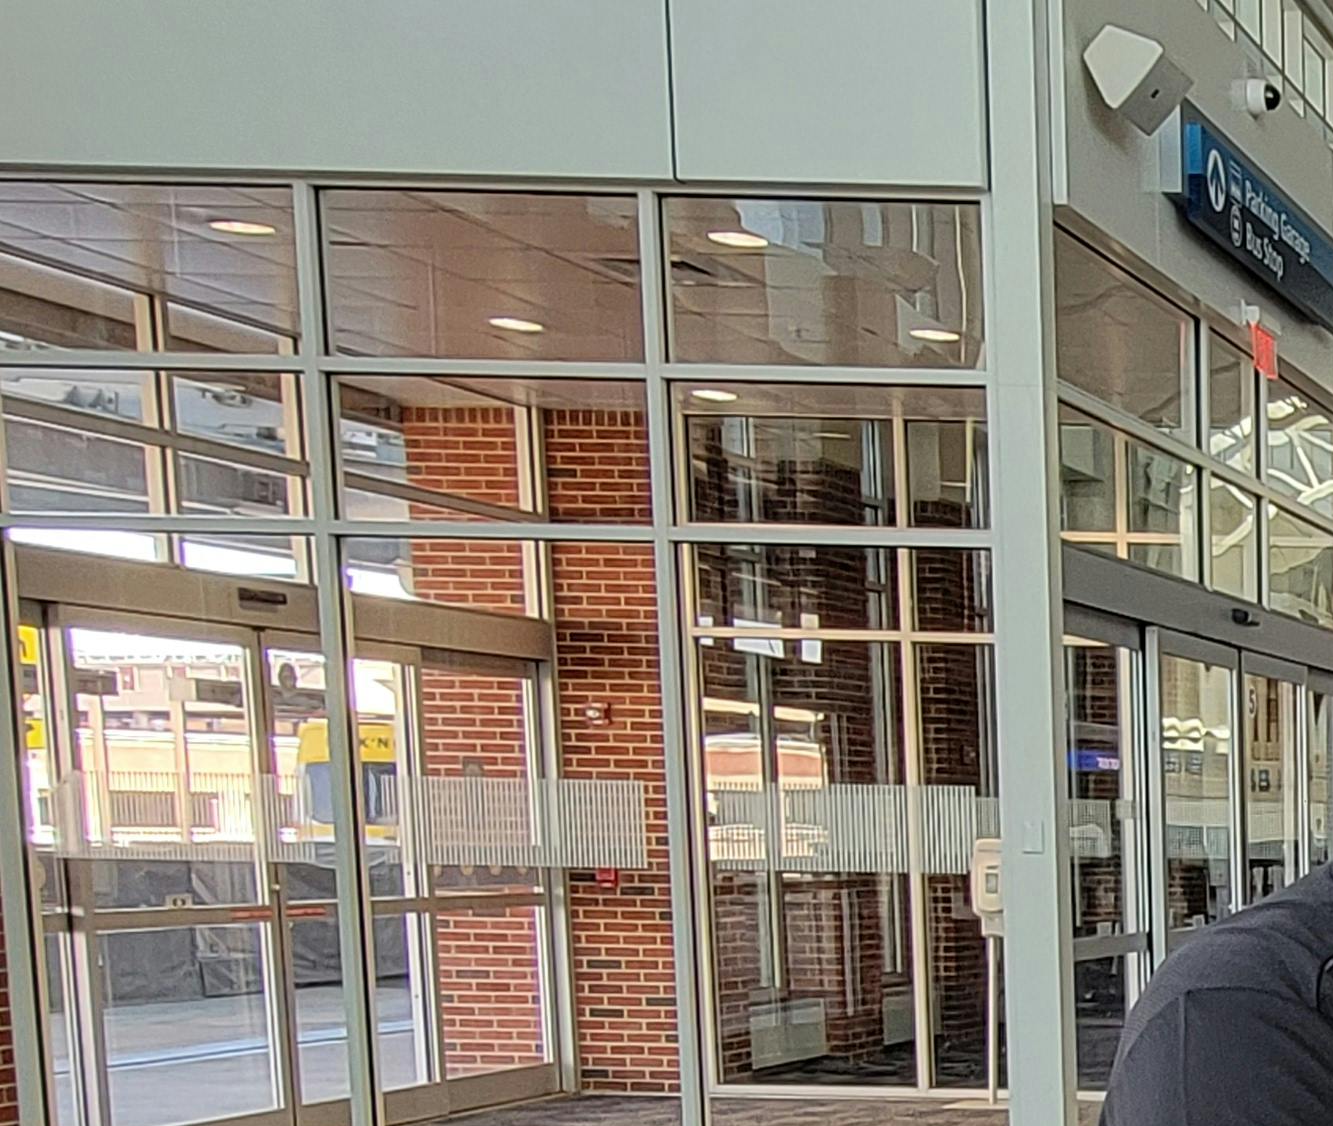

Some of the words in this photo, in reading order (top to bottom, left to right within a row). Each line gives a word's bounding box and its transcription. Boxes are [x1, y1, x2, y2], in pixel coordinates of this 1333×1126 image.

[1245, 180, 1279, 240] Parking
[1281, 212, 1310, 264] Garage
[1246, 221, 1262, 259] Bus
[1264, 237, 1283, 281] Stop
